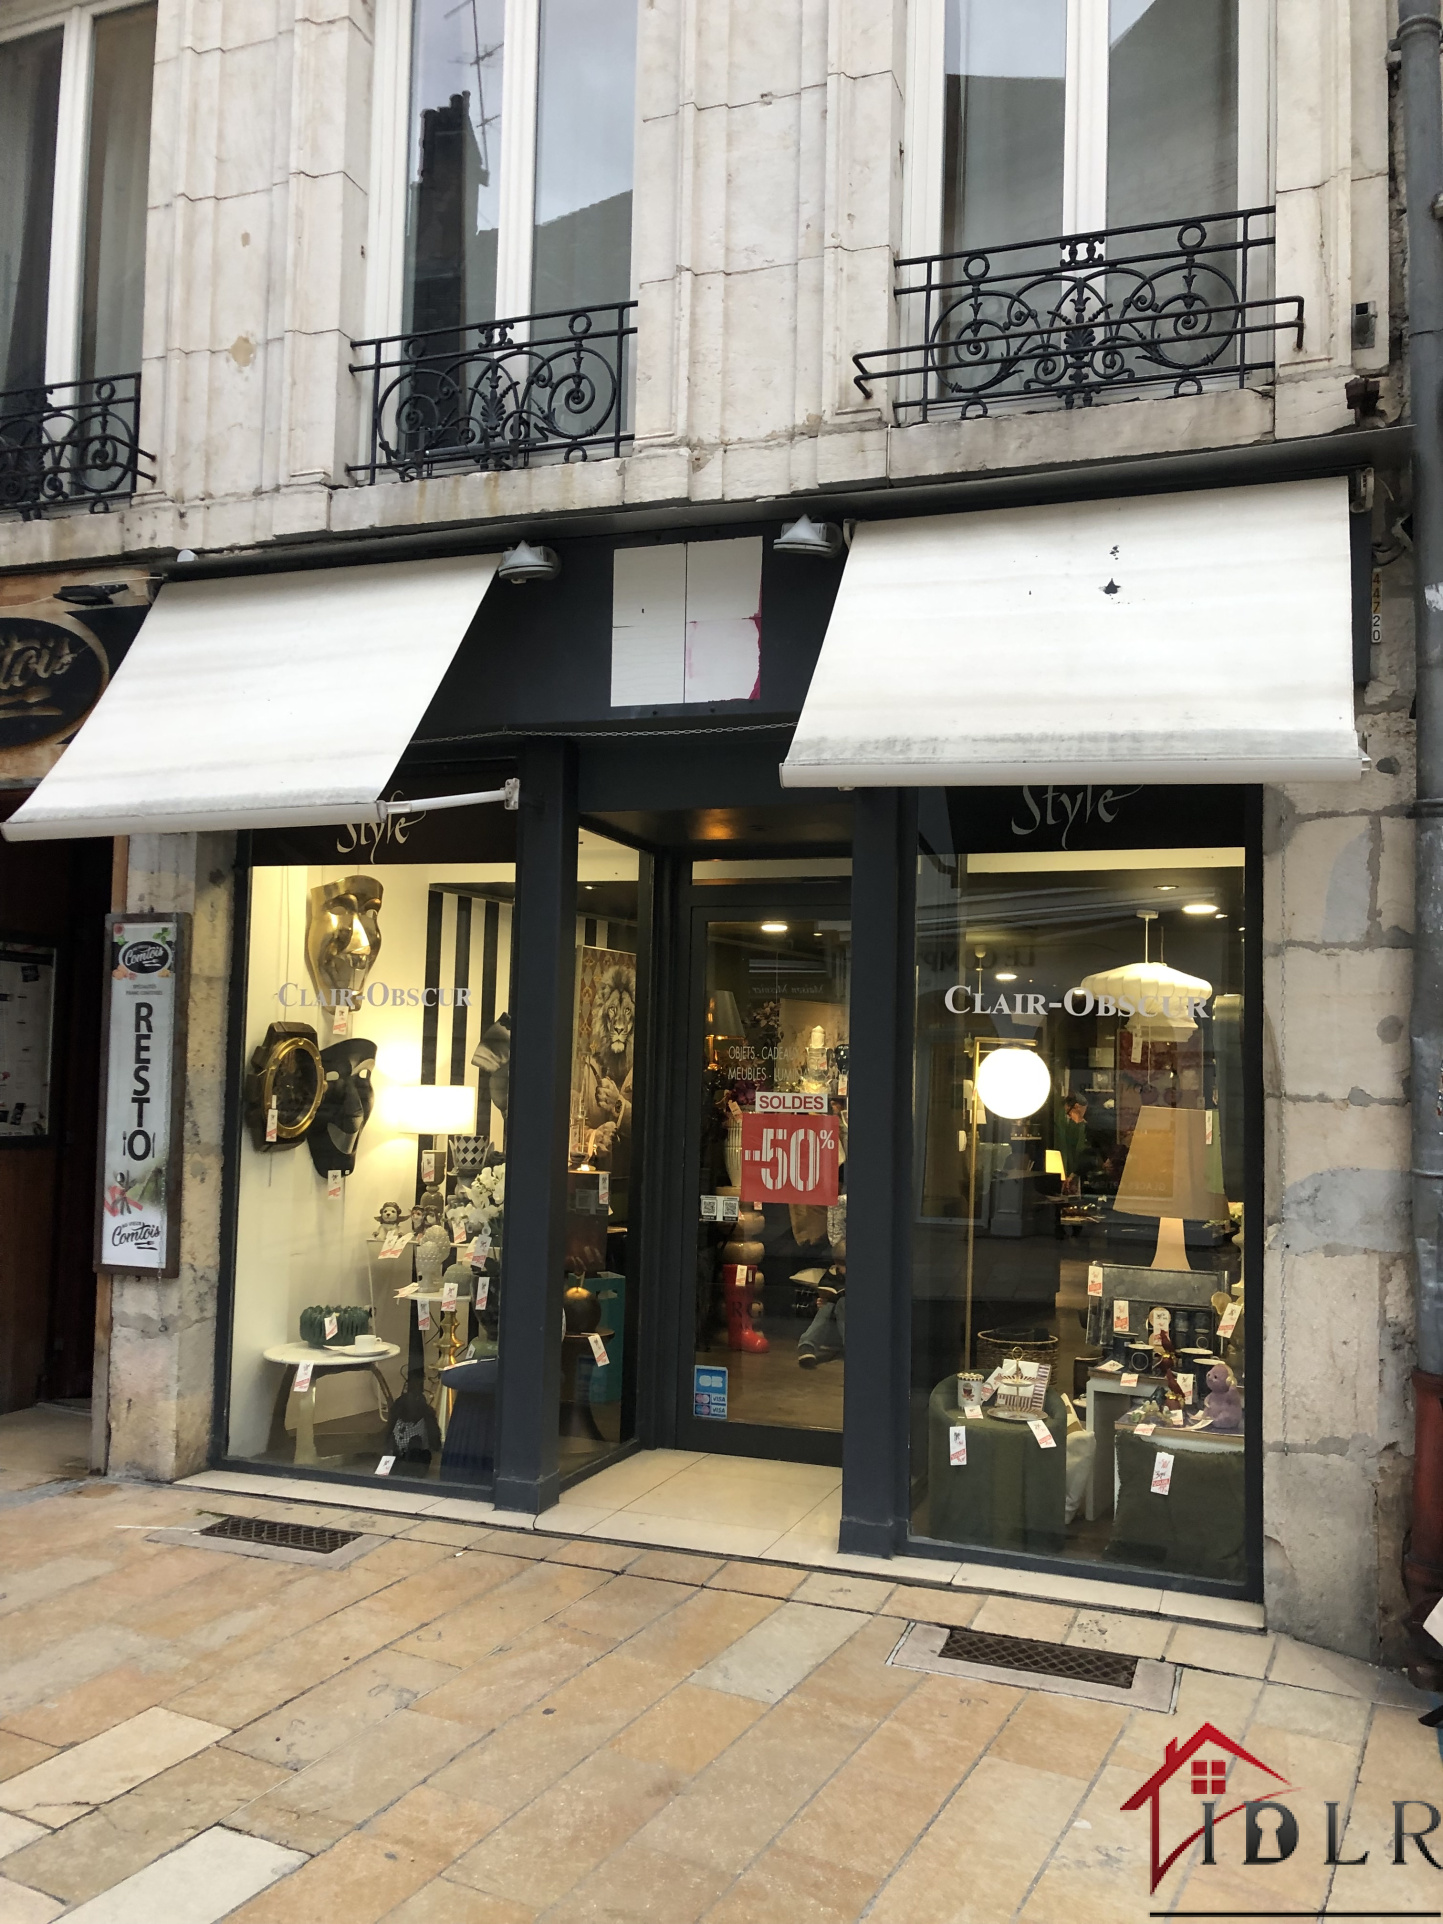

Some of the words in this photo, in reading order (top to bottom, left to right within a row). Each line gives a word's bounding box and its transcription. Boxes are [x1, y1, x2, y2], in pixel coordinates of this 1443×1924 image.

[728, 1045, 755, 1060] OBJETS
[728, 1066, 767, 1081] MEUBLES
[127, 1002, 153, 1161] RESTO
[759, 1095, 825, 1110] SOLDES
[111, 1222, 161, 1247] Comtois
